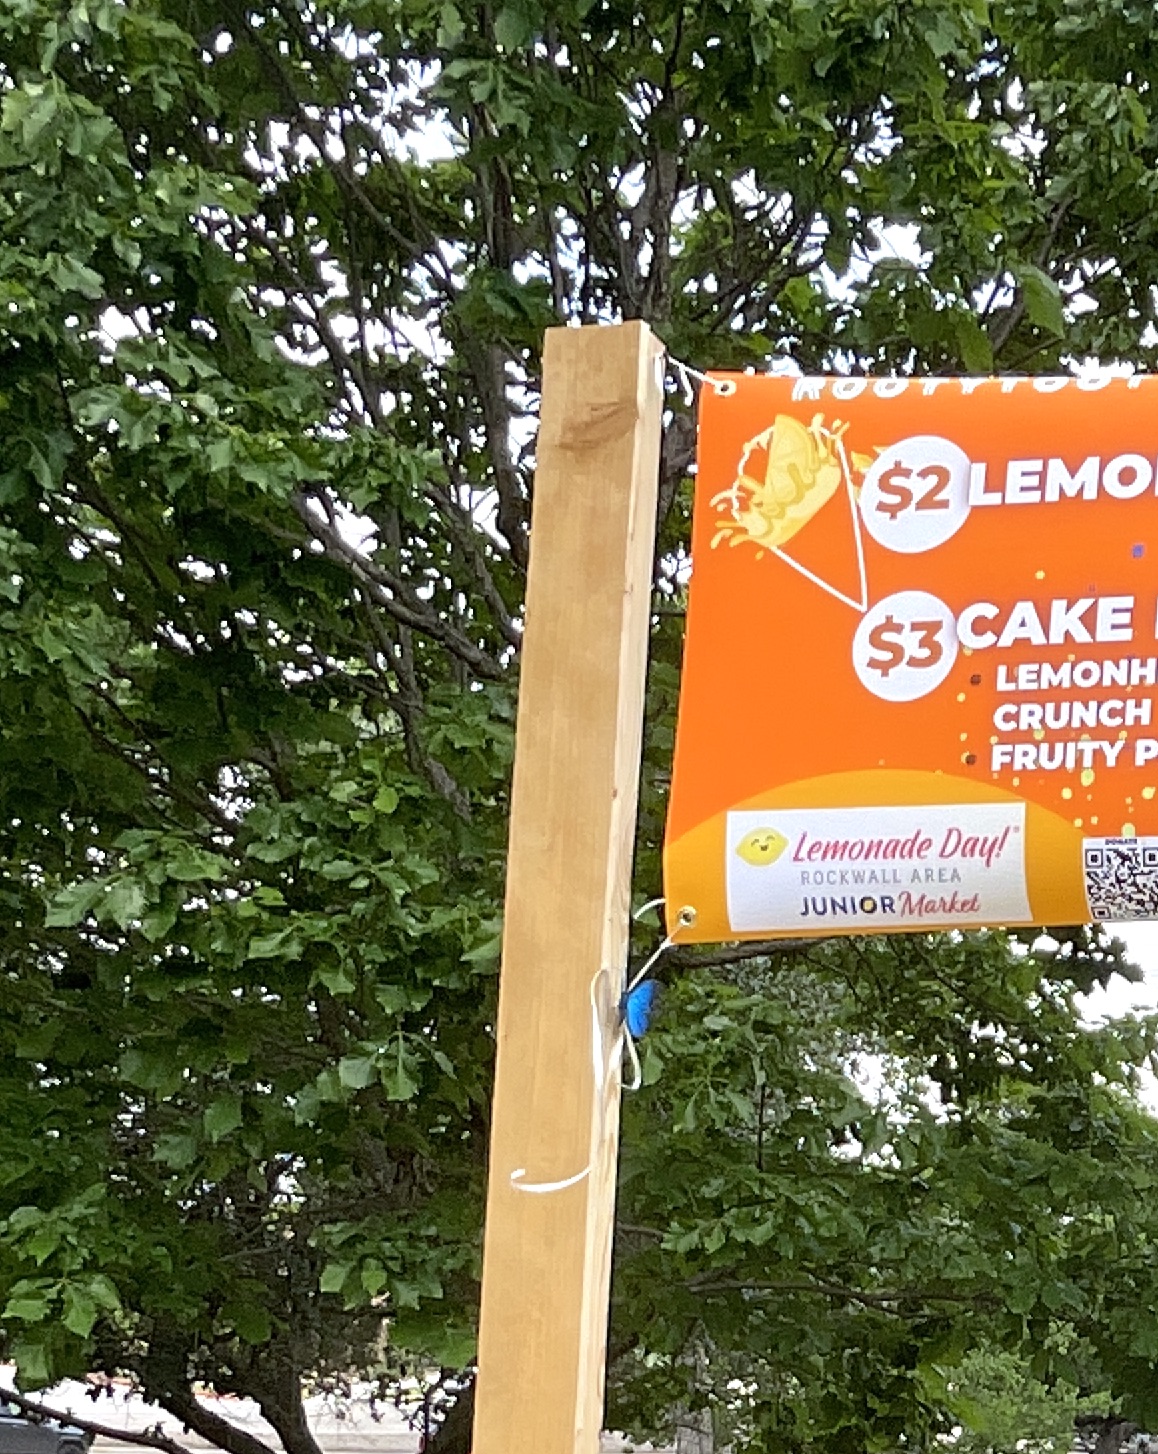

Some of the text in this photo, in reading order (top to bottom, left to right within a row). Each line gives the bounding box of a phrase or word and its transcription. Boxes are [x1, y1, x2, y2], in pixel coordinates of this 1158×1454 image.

[877, 460, 953, 520] $2
[866, 615, 944, 679] $3
[957, 593, 1134, 651] CAKE
[993, 698, 1151, 732] CRUNCH
[991, 739, 1125, 772] FRUITY
[793, 829, 932, 863] Lemonade
[801, 868, 962, 886] ROCKWALL AREA
[800, 890, 980, 917] JUNIOR Market
